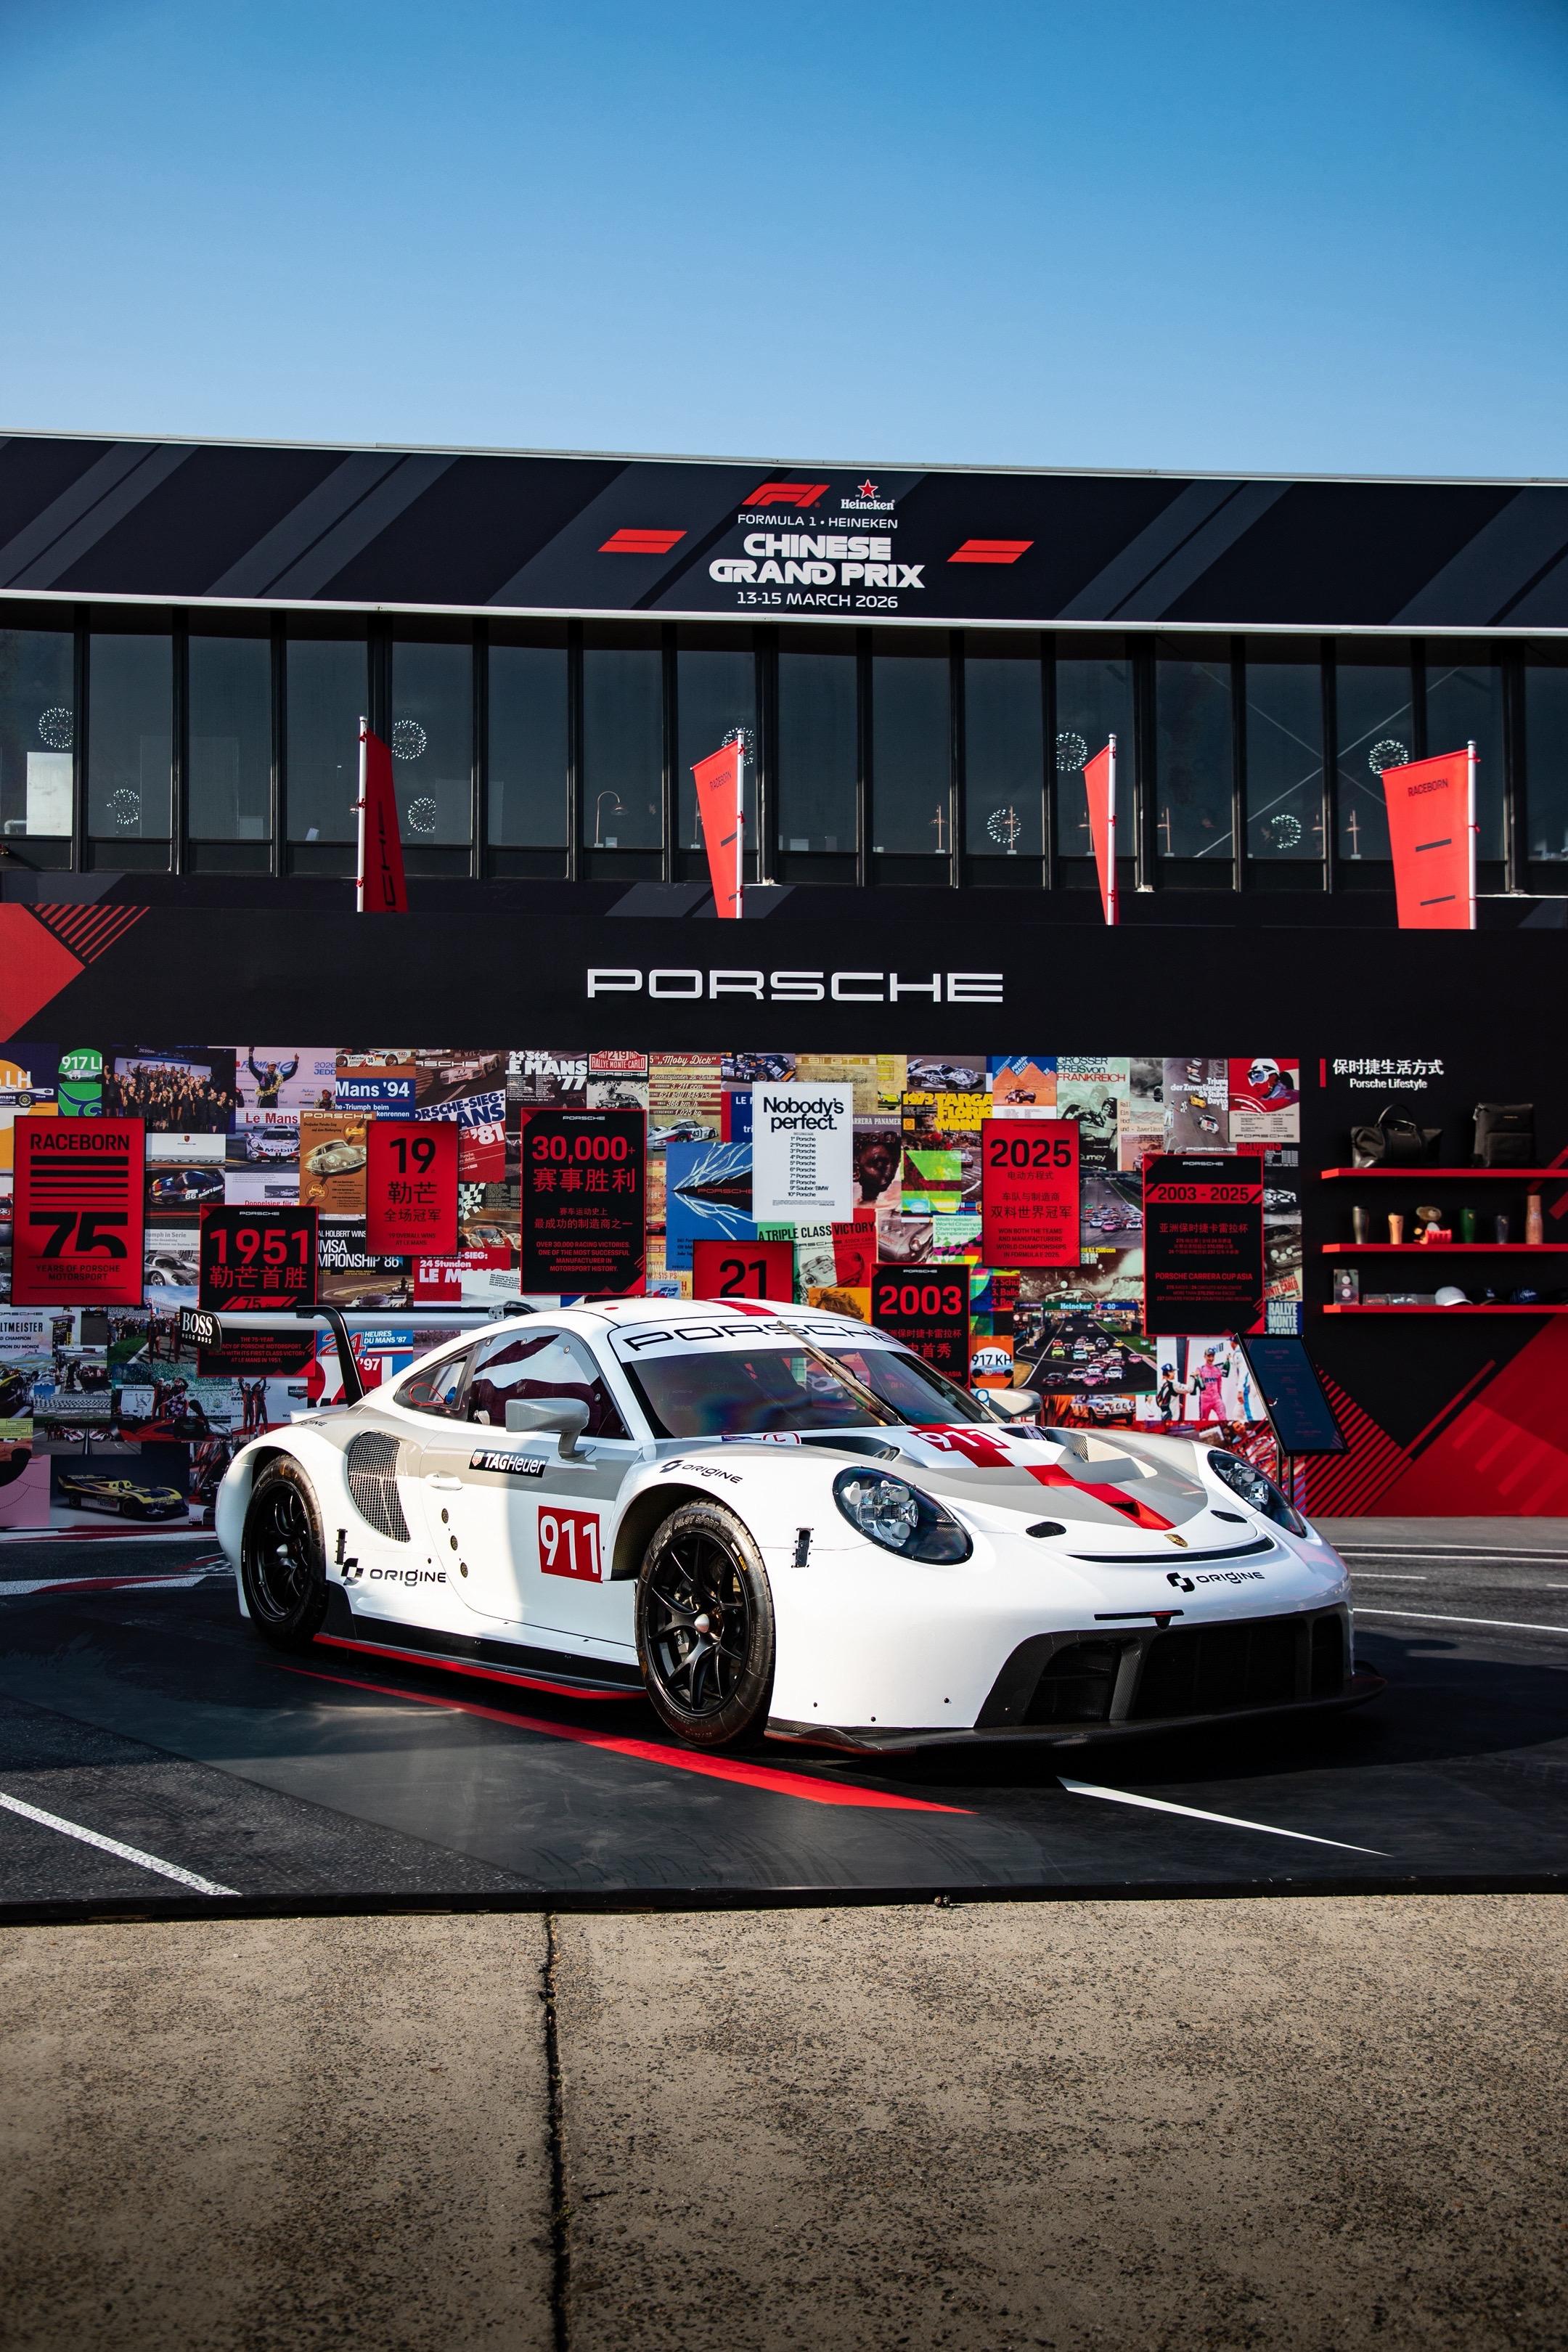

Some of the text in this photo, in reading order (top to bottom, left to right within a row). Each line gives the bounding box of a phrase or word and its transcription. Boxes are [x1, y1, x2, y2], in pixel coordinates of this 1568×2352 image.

[840, 499, 895, 510] Heineken
[738, 514, 899, 529] FORMULA 1 HEINEKEN
[743, 533, 892, 561] CHINESE
[709, 559, 926, 589] GRAND PRIX
[737, 592, 899, 608] 13-15 MARCH 2026
[1407, 778, 1450, 798] RACEBORN
[587, 968, 1003, 1003] PORSCHE
[62, 1056, 89, 1070] 917
[509, 1050, 525, 1061] 24
[524, 1061, 588, 1075] MANS
[592, 1058, 645, 1070] RALLYE MONTE-CARLO
[1332, 1058, 1445, 1075] 保时捷生活方式
[6, 1071, 31, 1088] LH
[557, 1076, 587, 1090] '77
[1056, 1073, 1126, 1082] FRANKREICH
[1349, 1078, 1428, 1090] Porsche Lifestyle
[335, 1081, 410, 1098] Mans '94
[735, 1096, 747, 1105] LE
[763, 1096, 844, 1115] Nobody's
[245, 1112, 298, 1124] Le Mans
[771, 1114, 838, 1132] perfect.
[30, 1133, 130, 1151] RACEBORN
[389, 1137, 436, 1174] 19
[989, 1138, 1071, 1167] 2025
[533, 1167, 636, 1193] 赛事胜利
[1007, 1171, 1055, 1180] 电动方程式
[387, 1181, 438, 1205] 勒芒
[1001, 1191, 1060, 1202] 车队与制造商
[1157, 1186, 1249, 1201] 2003 2025
[384, 1208, 441, 1222] 全场冠军
[990, 1205, 1071, 1219] 双料世界冠军
[534, 1218, 633, 1230] 最成功的制造商之一
[766, 1228, 799, 1242] TRIPLE
[801, 1225, 832, 1238] CLASS
[834, 1221, 875, 1235] VICTORY
[1159, 1223, 1249, 1233] 亚洲保时捷卡雷拉杯
[29, 1212, 128, 1259] 75
[209, 1229, 308, 1265] 1951
[37, 1264, 121, 1273] YEARS OF PORSCHE
[419, 1269, 439, 1283] LE
[48, 1273, 108, 1281] MOTORSPORT
[208, 1266, 307, 1289] 勒芒首胜
[719, 1259, 768, 1300] 21
[878, 1285, 963, 1315] 2003
[1267, 1302, 1298, 1315] RALLYE
[181, 1311, 213, 1336] BOSS
[1267, 1315, 1298, 1328] MONTE
[197, 1336, 212, 1344] BOSS
[623, 1323, 905, 1352] PORSCHE
[971, 1354, 1012, 1366] 917 KH
[918, 1431, 1004, 1449] 911
[674, 1514, 721, 1530] PILOT SPORT
[540, 1515, 600, 1575] 911
